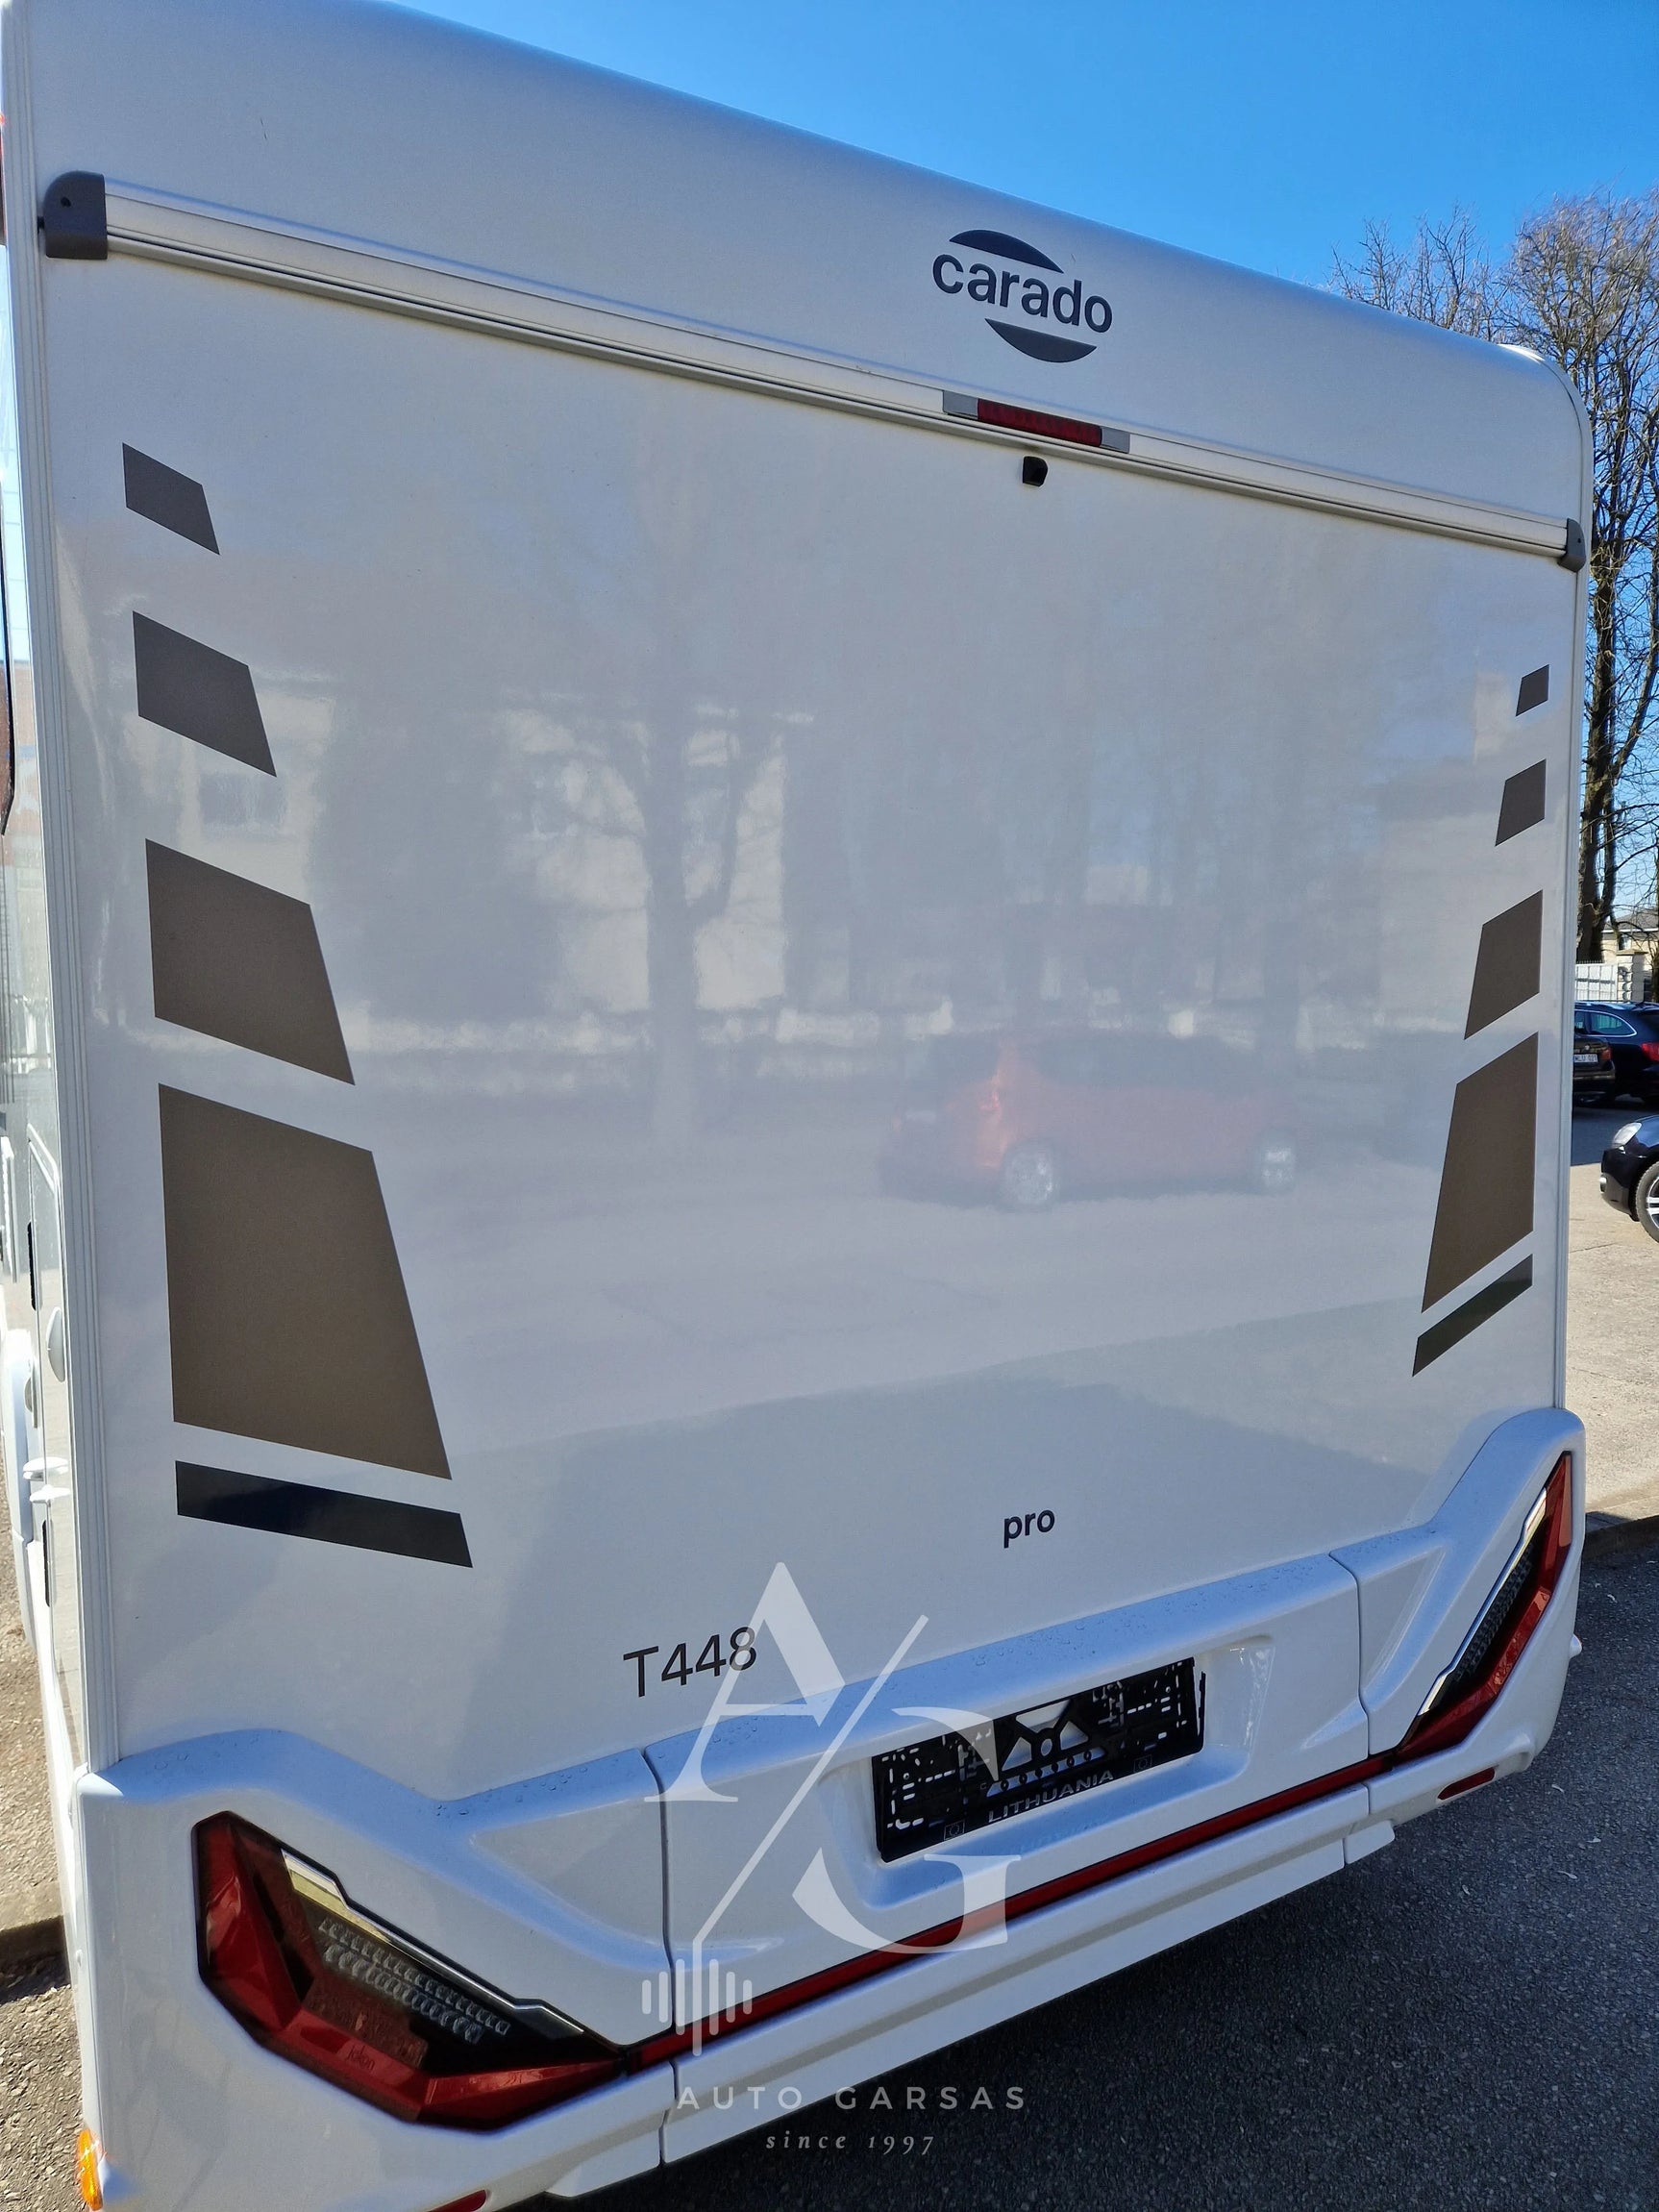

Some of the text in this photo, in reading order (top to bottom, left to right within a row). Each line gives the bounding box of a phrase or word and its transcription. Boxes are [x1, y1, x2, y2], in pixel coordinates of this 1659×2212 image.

[932, 253, 1113, 334] carado
[1003, 1508, 1055, 1549] pro
[623, 1626, 757, 1698] T448
[988, 1770, 1114, 1823] LITHUANIA
